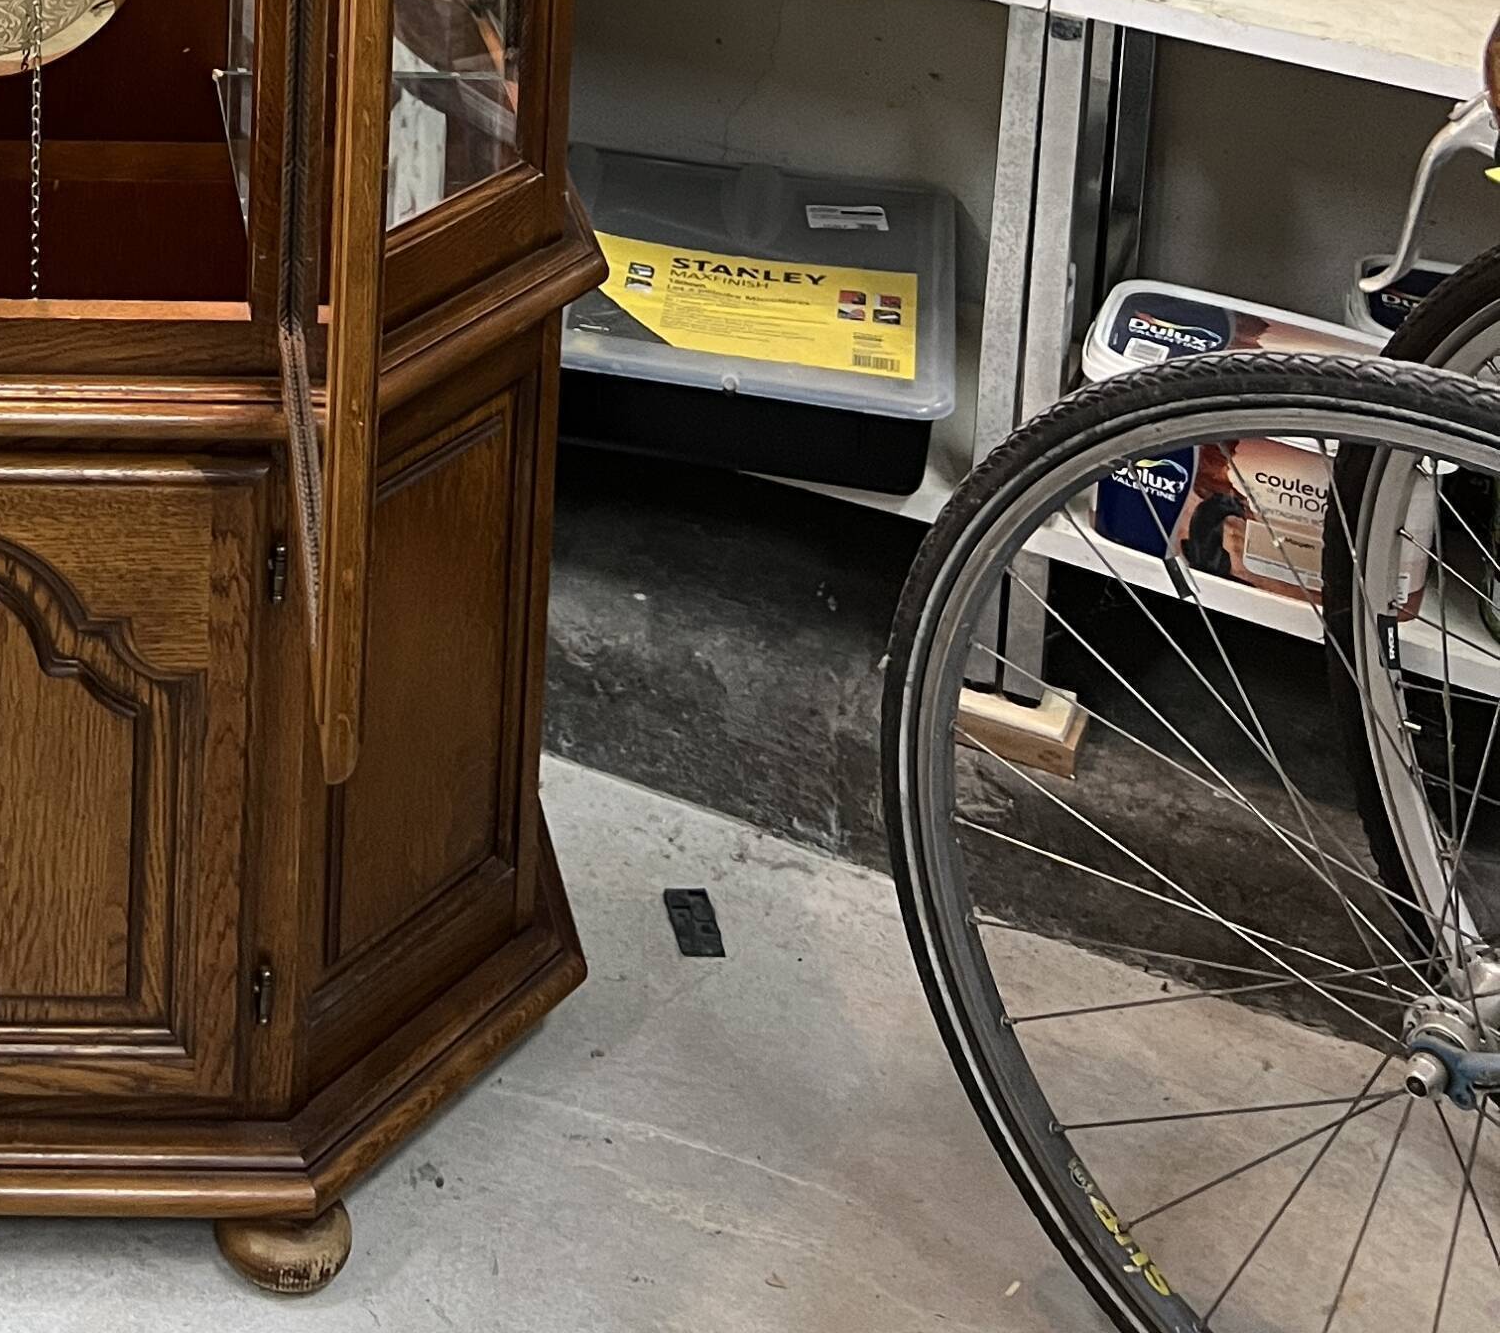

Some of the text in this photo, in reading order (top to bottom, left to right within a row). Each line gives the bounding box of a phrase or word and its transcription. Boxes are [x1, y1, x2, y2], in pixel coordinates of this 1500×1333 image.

[669, 269, 770, 290] MAXFINISH
[671, 257, 828, 286] STANLEY
[1128, 317, 1209, 348] Dulux
[1254, 471, 1329, 500] couleu
